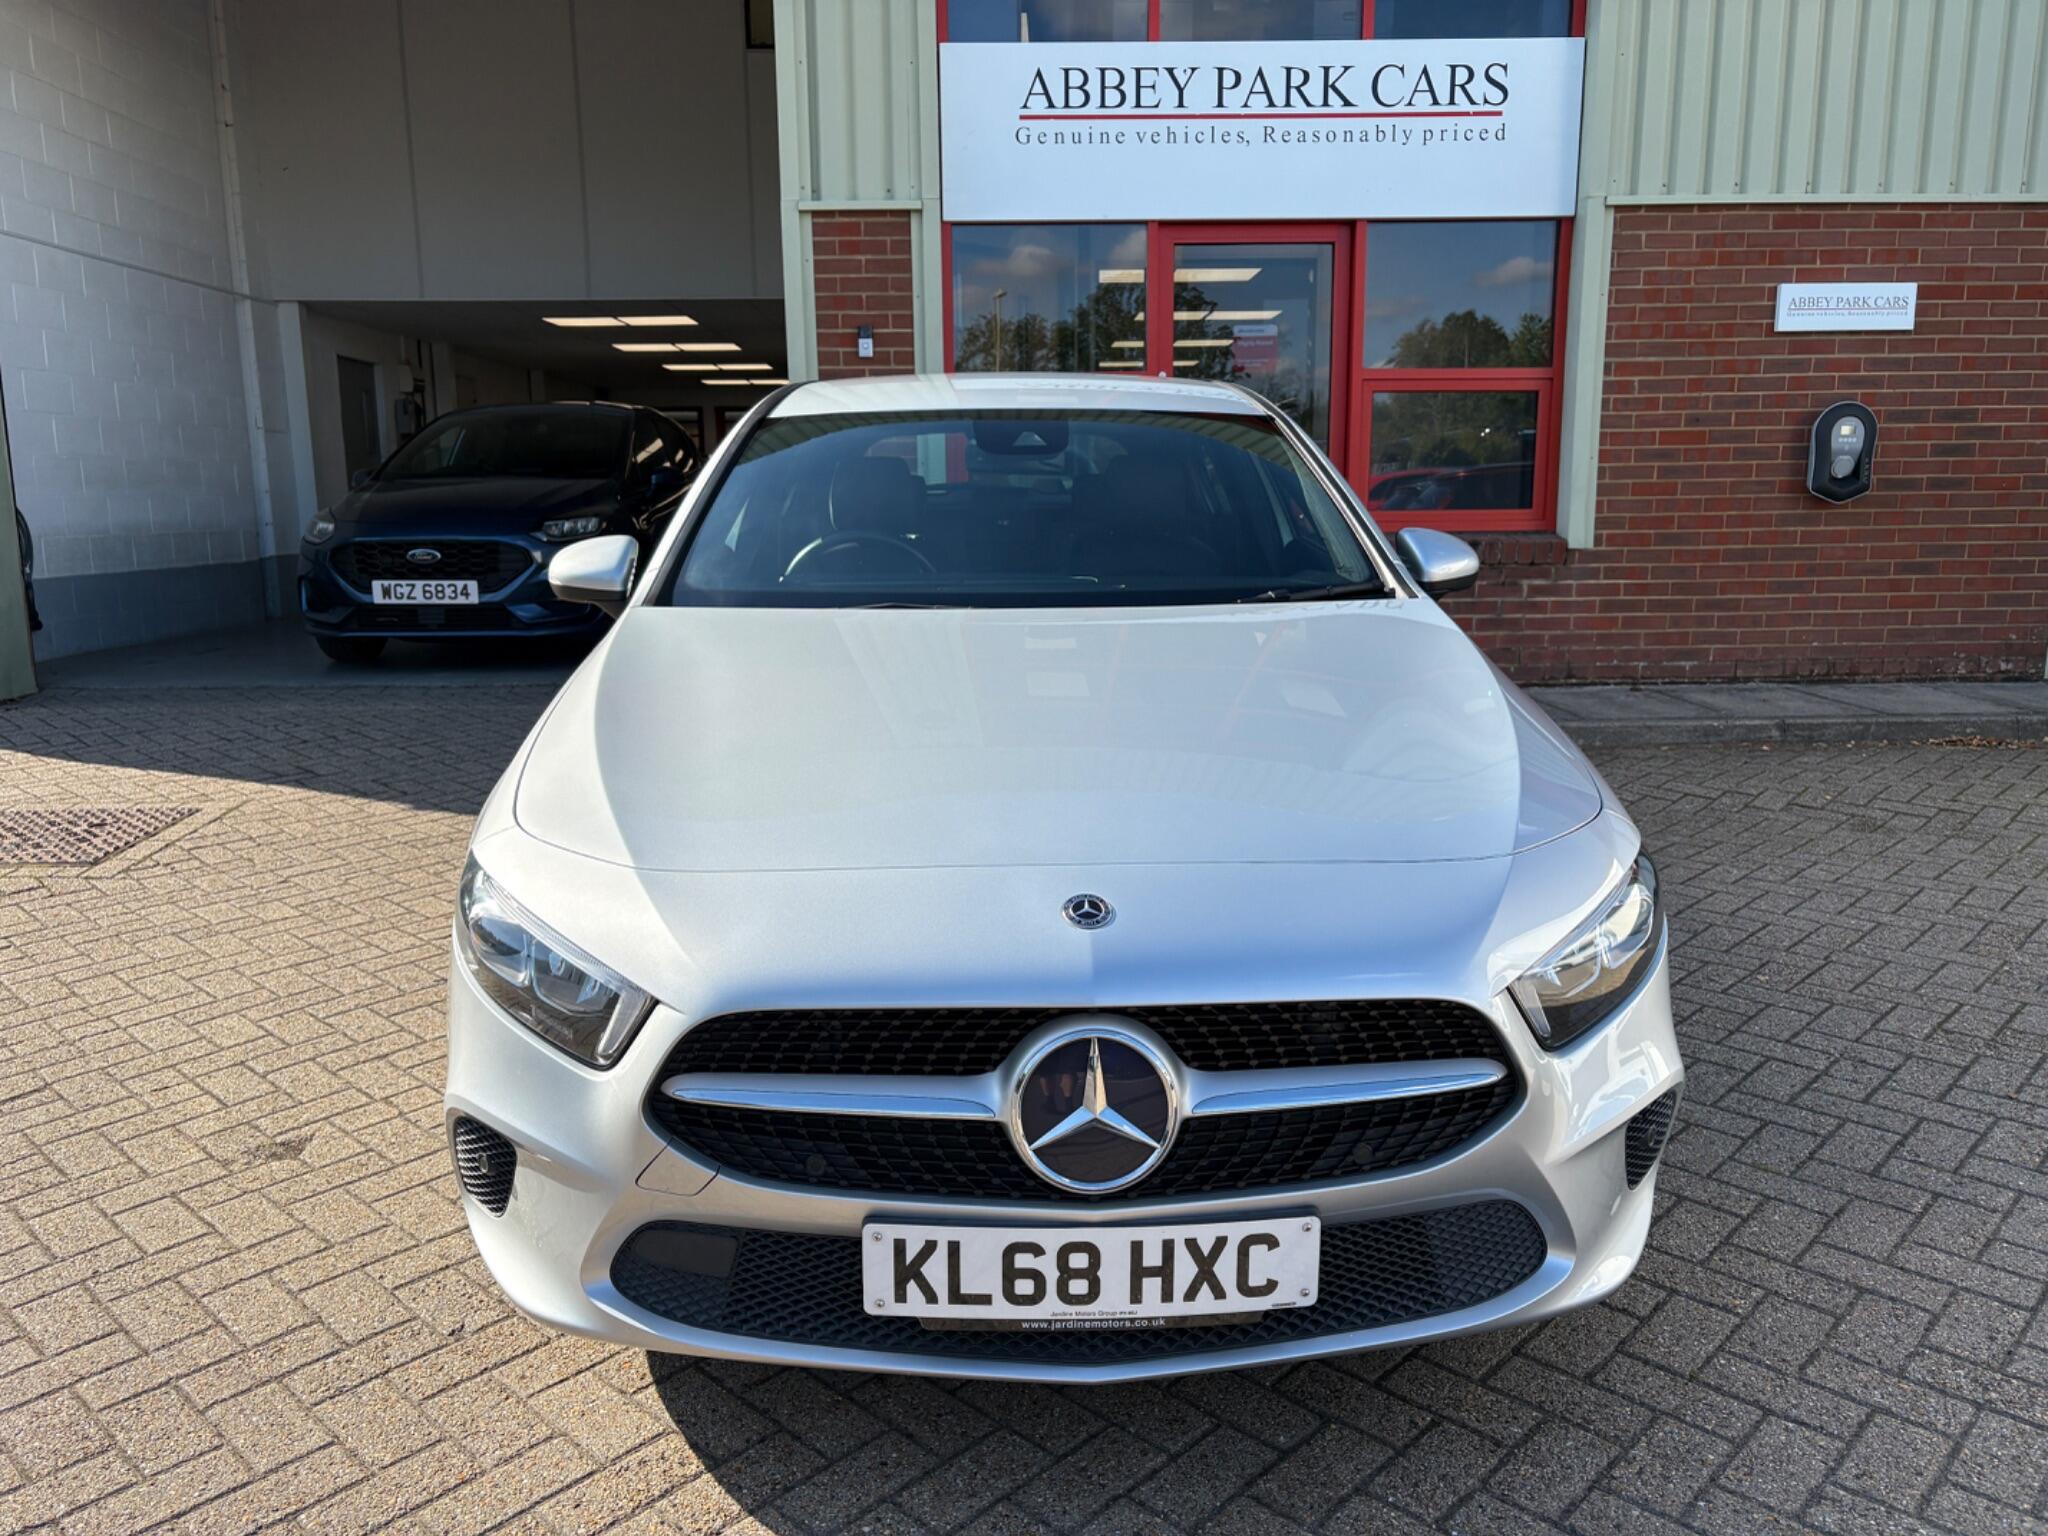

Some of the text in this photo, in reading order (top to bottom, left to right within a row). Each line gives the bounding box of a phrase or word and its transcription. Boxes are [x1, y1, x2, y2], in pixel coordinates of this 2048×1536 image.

[1020, 62, 1509, 111] ABBEY PARK CARS
[1014, 122, 1506, 147] Genuine vehicles, Reasonably priced
[1788, 295, 1909, 308] ABBEY PARK CARS
[380, 582, 471, 600] WGZ 6834
[892, 1232, 1280, 1307] KL68 HXC
[1021, 1317, 1166, 1331] www.jardinemotors.co.uk
